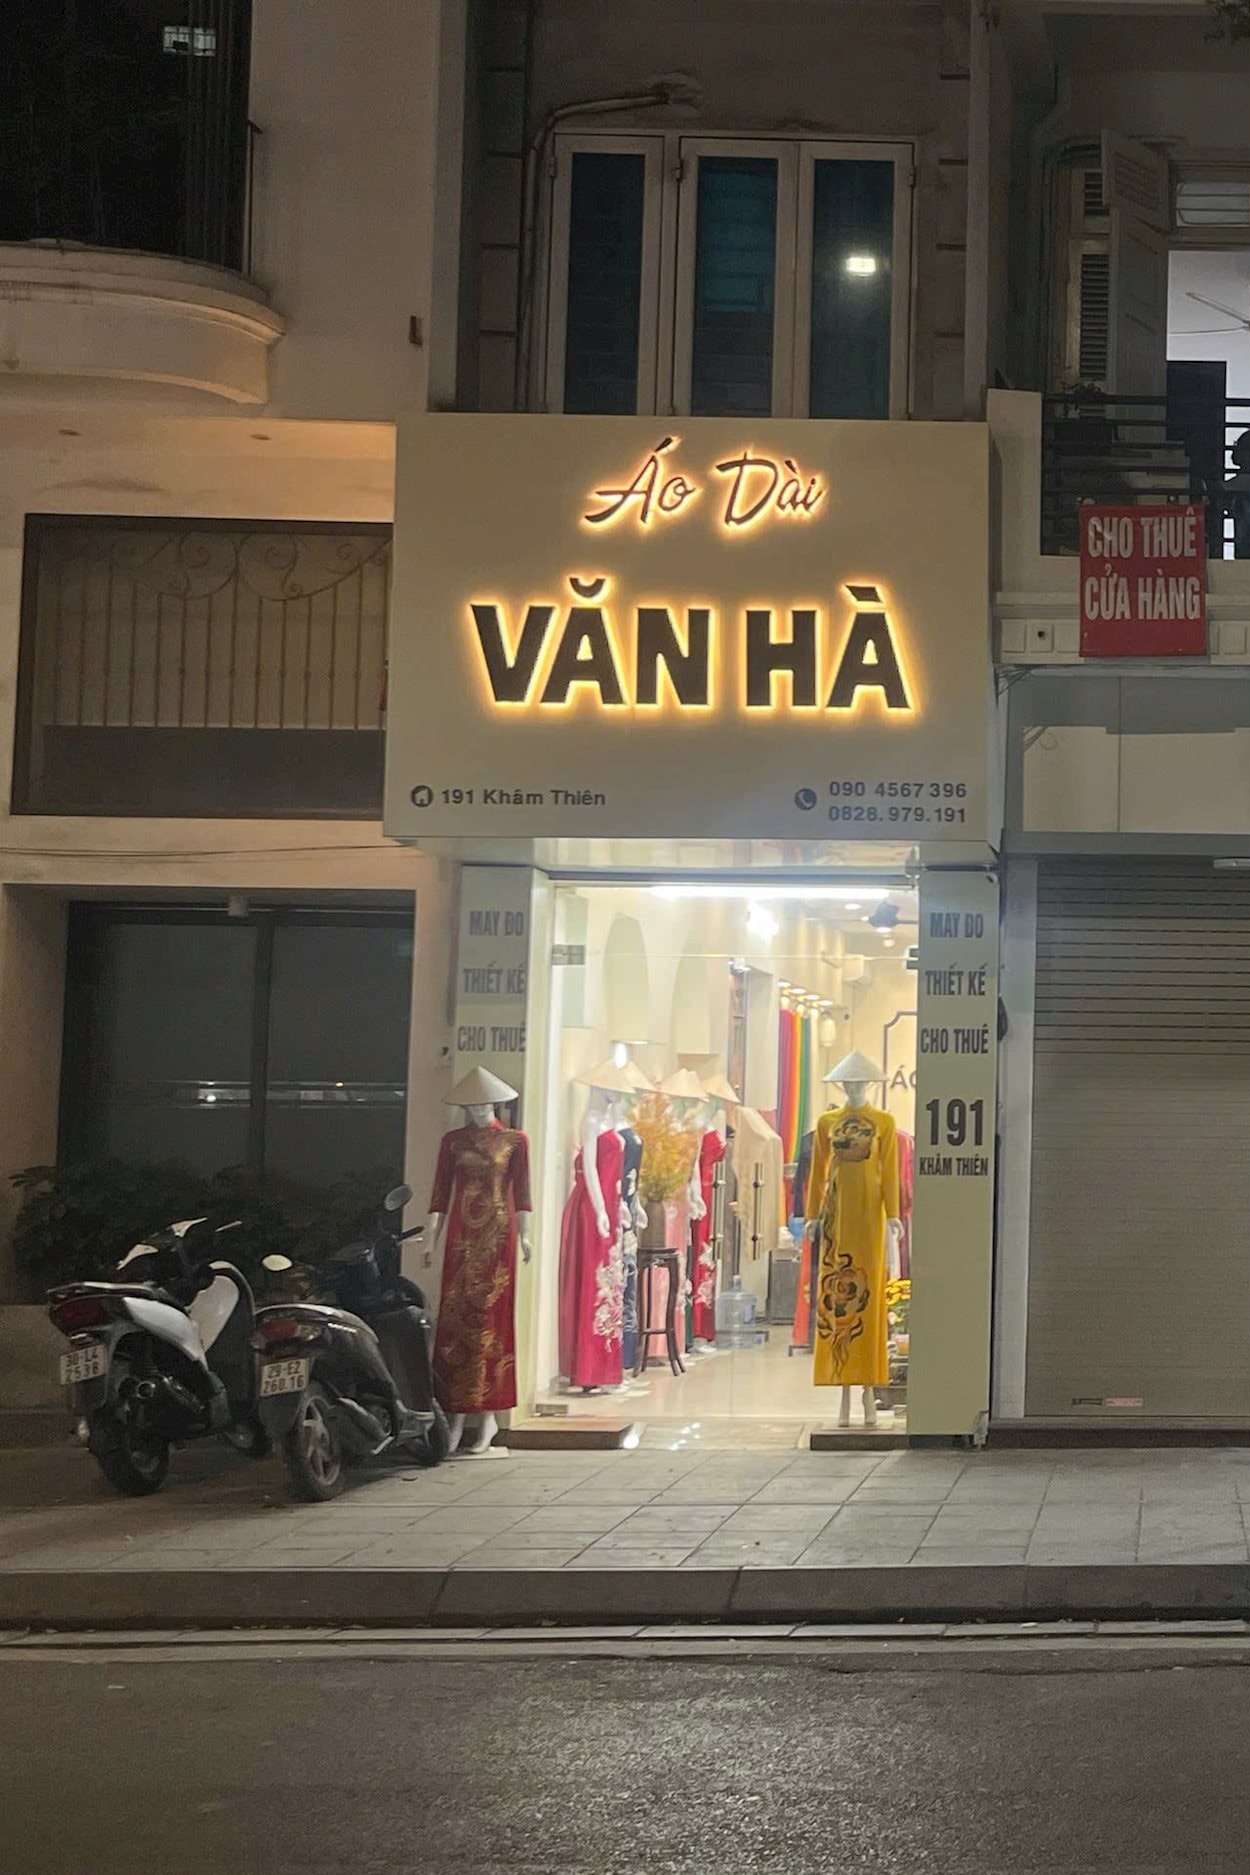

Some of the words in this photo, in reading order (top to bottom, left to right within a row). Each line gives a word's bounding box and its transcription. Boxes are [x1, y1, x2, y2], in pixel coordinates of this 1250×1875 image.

[584, 436, 696, 524] Áo
[715, 451, 823, 526] Dài
[1087, 516, 1134, 559] CHO
[1140, 507, 1197, 558] THUÊ
[1085, 563, 1131, 620] CỬA
[1138, 568, 1200, 620] HÀNG
[470, 577, 711, 707] VĂN
[745, 584, 912, 709] HÀ
[441, 789, 474, 805] 191
[483, 788, 544, 805] Khâm
[551, 789, 606, 806] Thiên
[829, 781, 866, 797] 090
[875, 782, 924, 798] 4567
[929, 782, 967, 798] 396
[828, 805, 967, 824] 0828.979.191
[469, 910, 500, 936] MAY
[930, 912, 960, 938] MAY
[463, 960, 503, 994] THIẾT
[507, 962, 526, 994] KẾ
[925, 962, 963, 996] THIẾT
[968, 962, 988, 996] KẾ
[457, 1026, 486, 1052] CHO
[490, 1021, 526, 1053] THUÊ
[920, 1027, 949, 1054] CHO
[953, 1023, 989, 1054] THUÊ
[926, 1098, 984, 1147] 191
[919, 1152, 953, 1176] KHÂM
[956, 1153, 989, 1177] THIÊN
